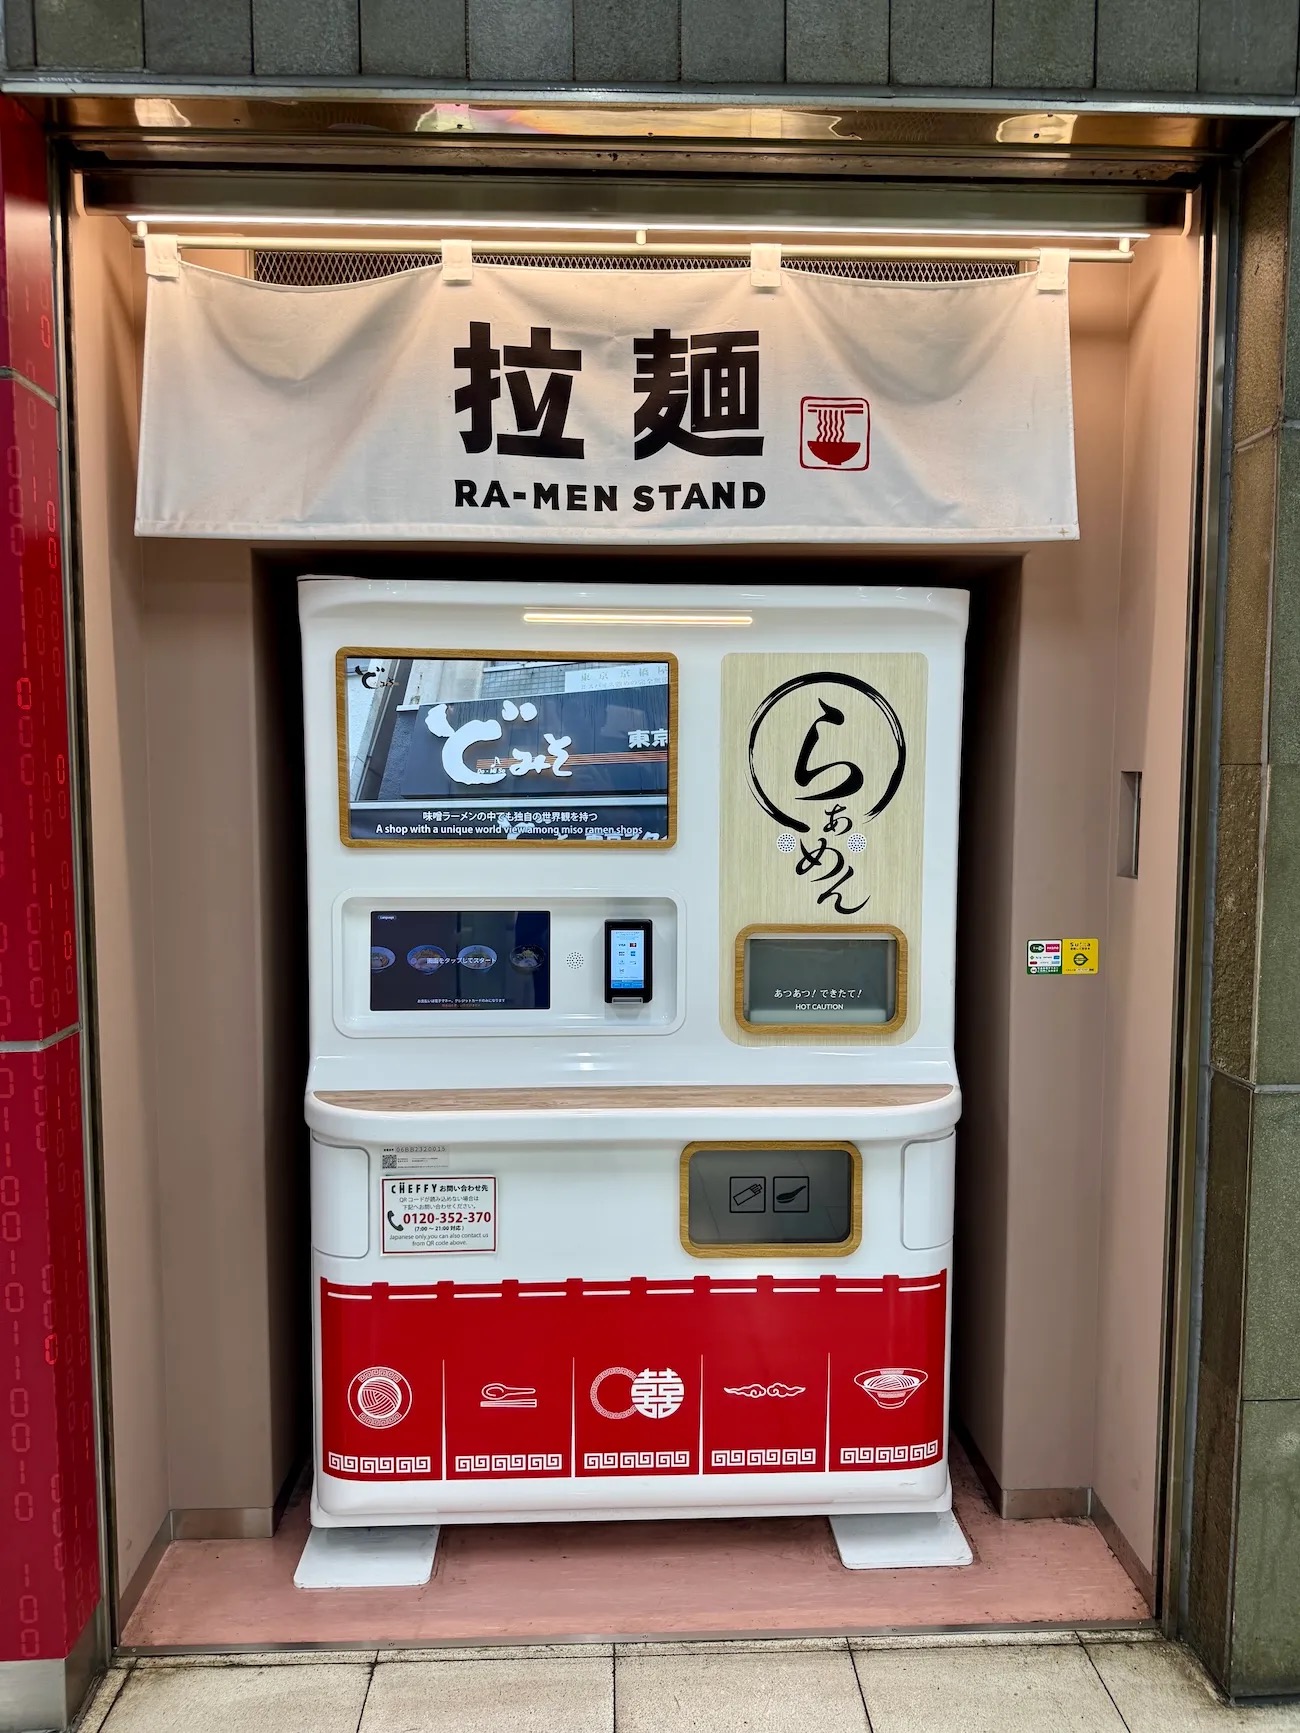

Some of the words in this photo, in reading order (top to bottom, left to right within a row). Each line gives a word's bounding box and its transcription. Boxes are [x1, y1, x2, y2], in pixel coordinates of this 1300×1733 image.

[454, 321, 764, 460] 拉麺
[454, 479, 618, 512] RA-MEN
[633, 481, 766, 512] STAND
[375, 824, 383, 834] A
[385, 824, 408, 835] shop
[410, 824, 431, 834] with
[432, 826, 439, 834] a
[440, 824, 473, 835] unique
[474, 824, 502, 834] world
[504, 824, 527, 834] view
[527, 826, 559, 835] among
[561, 825, 583, 834] miso
[585, 825, 615, 834] ramen
[615, 825, 643, 835] shops
[439, 1184, 489, 1193] お問い合わせ先
[403, 1212, 492, 1224] 0120-352-370
